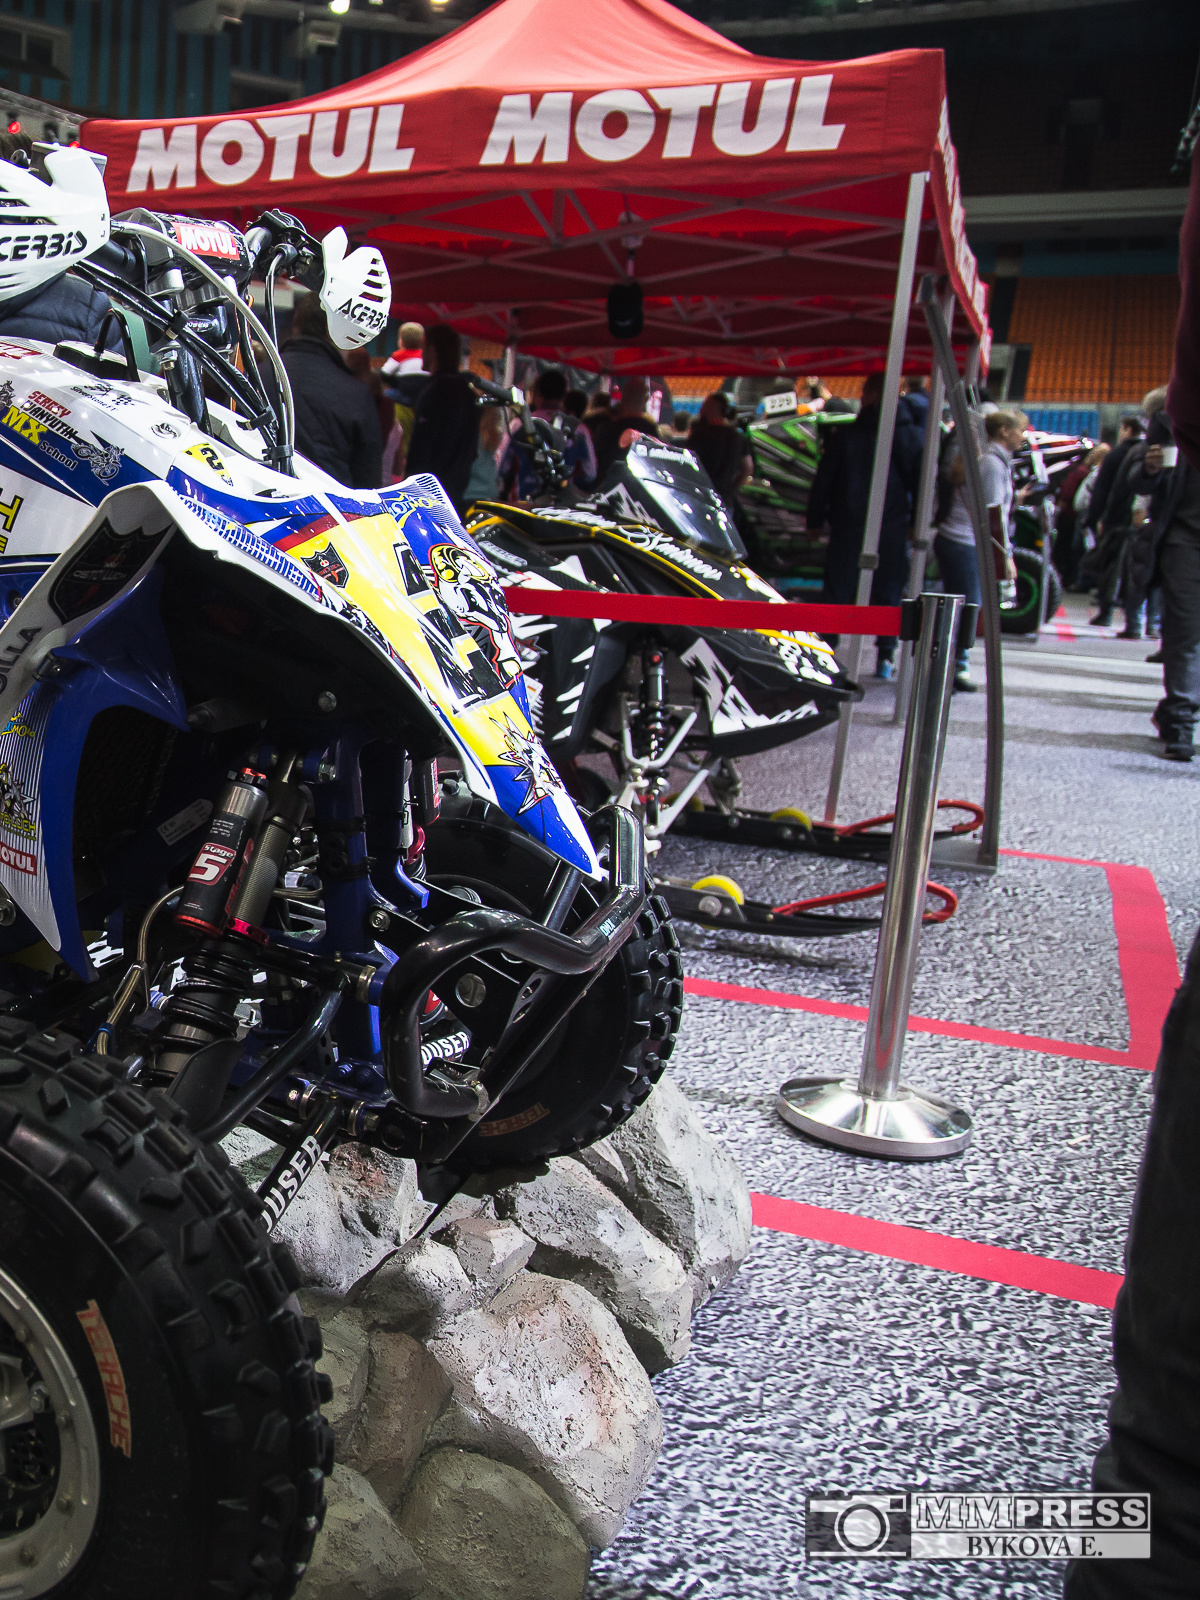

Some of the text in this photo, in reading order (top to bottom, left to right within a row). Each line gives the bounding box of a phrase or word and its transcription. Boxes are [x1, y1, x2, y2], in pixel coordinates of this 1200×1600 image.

[480, 74, 846, 166] MOTUL
[127, 104, 416, 194] MOTUL
[179, 225, 237, 256] MOTUL
[0, 405, 79, 471] MX School
[188, 852, 228, 881] 5
[204, 844, 234, 858] stage
